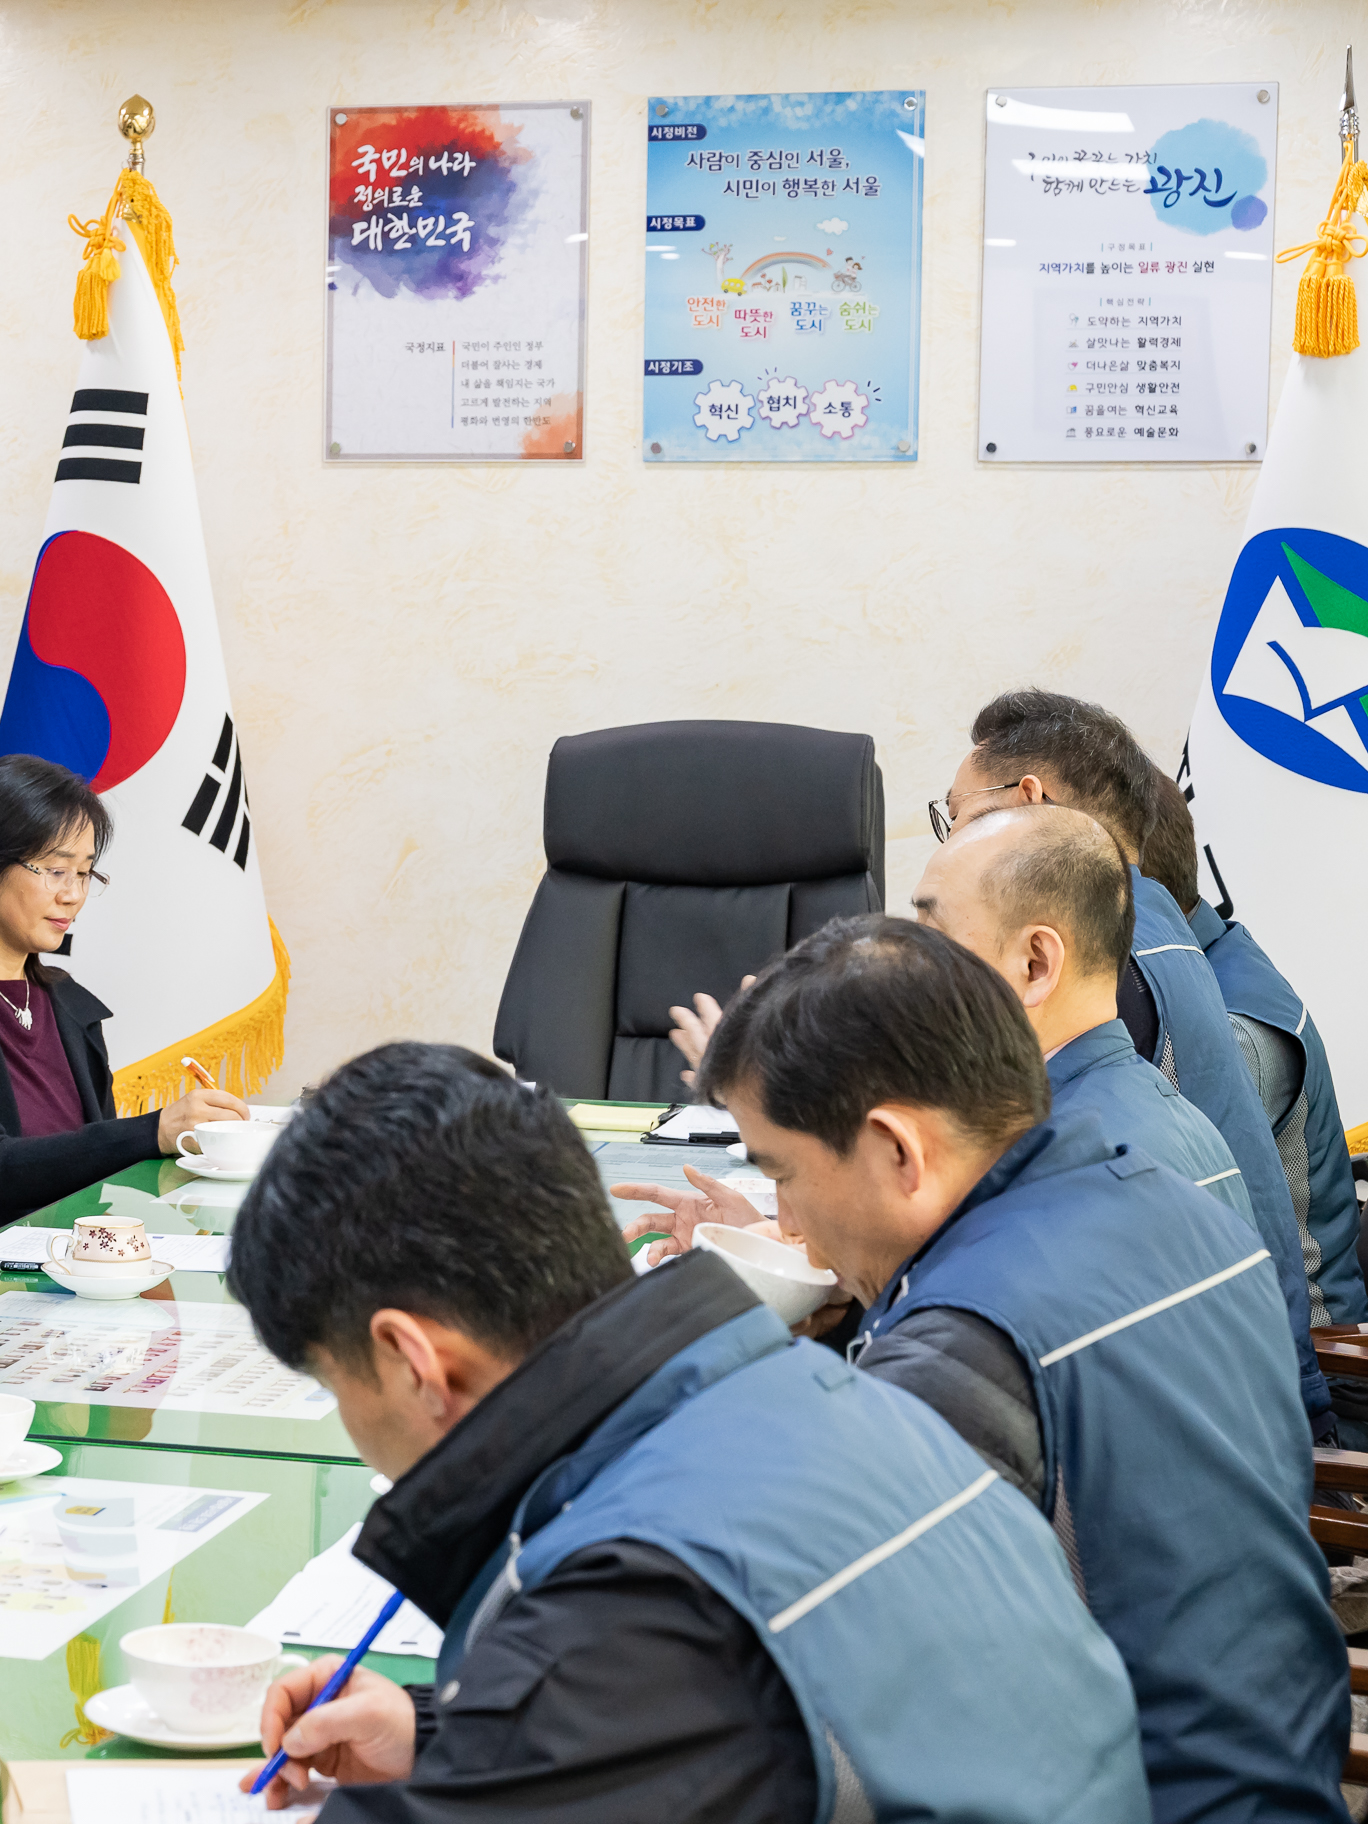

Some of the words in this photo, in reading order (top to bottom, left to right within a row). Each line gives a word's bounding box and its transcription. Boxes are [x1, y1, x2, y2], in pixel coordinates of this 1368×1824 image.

[651, 126, 698, 140] 시정비전
[351, 144, 424, 182] 국민의
[429, 151, 476, 177] 나라
[687, 151, 740, 172] 사람이
[747, 150, 800, 171] 중심인
[806, 148, 850, 169] 서울,
[724, 179, 776, 199] 시민이
[782, 178, 836, 199] 행복한
[843, 177, 880, 197] 서울
[1143, 166, 1238, 208] 광진
[353, 185, 423, 212] 정의로운
[650, 216, 696, 230] 시정목표
[350, 211, 476, 252] 대한민국
[1039, 262, 1096, 275] 지역가치를
[1101, 261, 1134, 275] 높이는
[1138, 261, 1160, 275] 일류
[1165, 261, 1188, 275] 광진
[1192, 260, 1215, 274] 실현
[687, 297, 726, 312] 안전한
[790, 302, 828, 317] 꿈꾸는
[839, 302, 878, 317] 숨쉬는
[693, 314, 721, 328] 도시
[734, 309, 773, 324] 따뜻한
[1087, 316, 1132, 328] 도약하는
[1138, 315, 1182, 328] 지역가치
[796, 318, 822, 333] 도시
[844, 318, 871, 332] 도시
[741, 326, 767, 340] 도시
[404, 341, 446, 353] 국정지표
[461, 341, 491, 352] 국민이
[525, 340, 544, 352] 정부
[1086, 337, 1131, 349] 살맛나는
[1137, 336, 1181, 349] 활력경제
[648, 361, 694, 374] 시정기조
[1086, 360, 1130, 372] 더나은삶
[1136, 359, 1181, 372] 맞춤복지
[1085, 382, 1129, 395] 구민안심
[1136, 382, 1180, 394] 생활안전
[767, 396, 797, 411] 협치
[823, 401, 854, 418] 소통
[1085, 404, 1128, 417] 꿈을여는
[1135, 404, 1179, 417] 혁신교육
[709, 404, 739, 420] 혁신
[1084, 426, 1127, 439] 풍요로운
[1134, 426, 1179, 438] 예술문화
